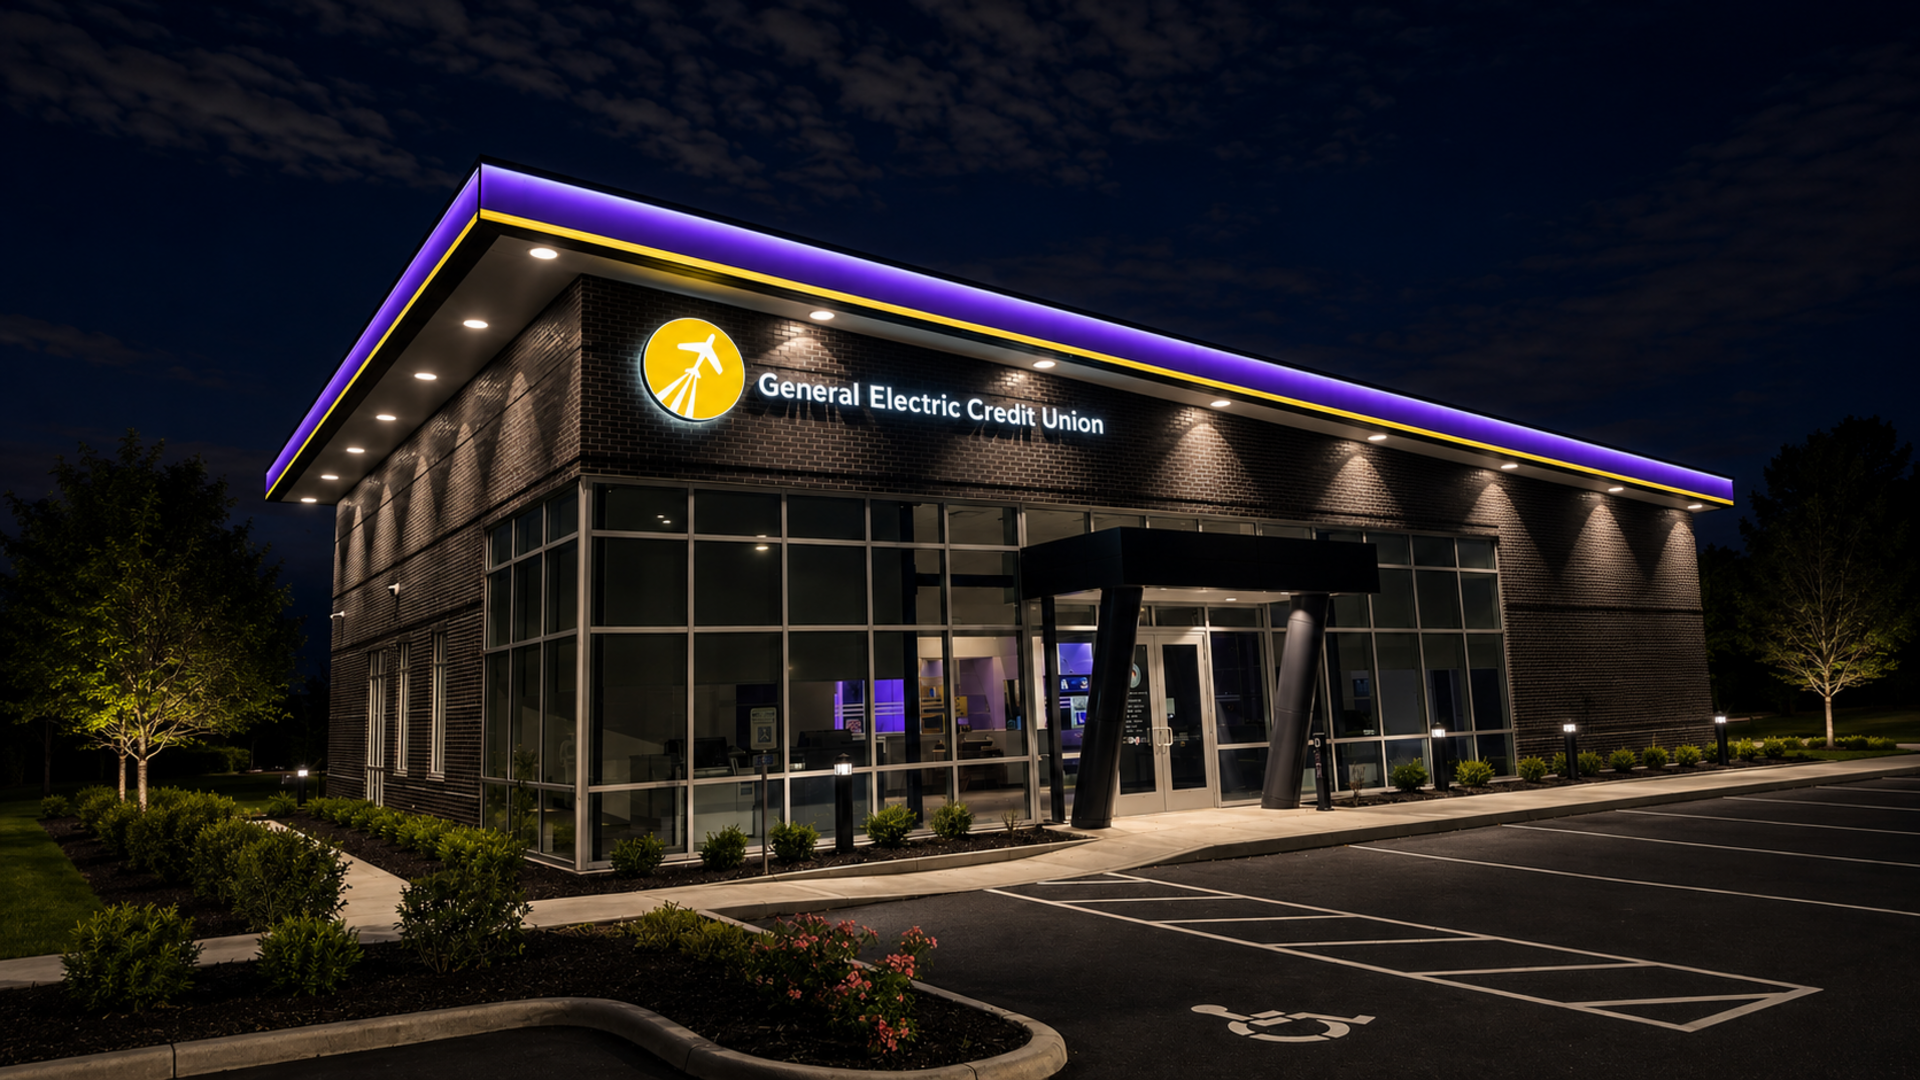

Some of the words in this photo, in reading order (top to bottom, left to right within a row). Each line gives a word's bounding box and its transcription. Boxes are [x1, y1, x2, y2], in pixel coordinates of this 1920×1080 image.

[758, 372, 860, 406] General
[869, 384, 961, 418] Electric
[967, 398, 1036, 427] Credit
[1042, 406, 1104, 434] Union
